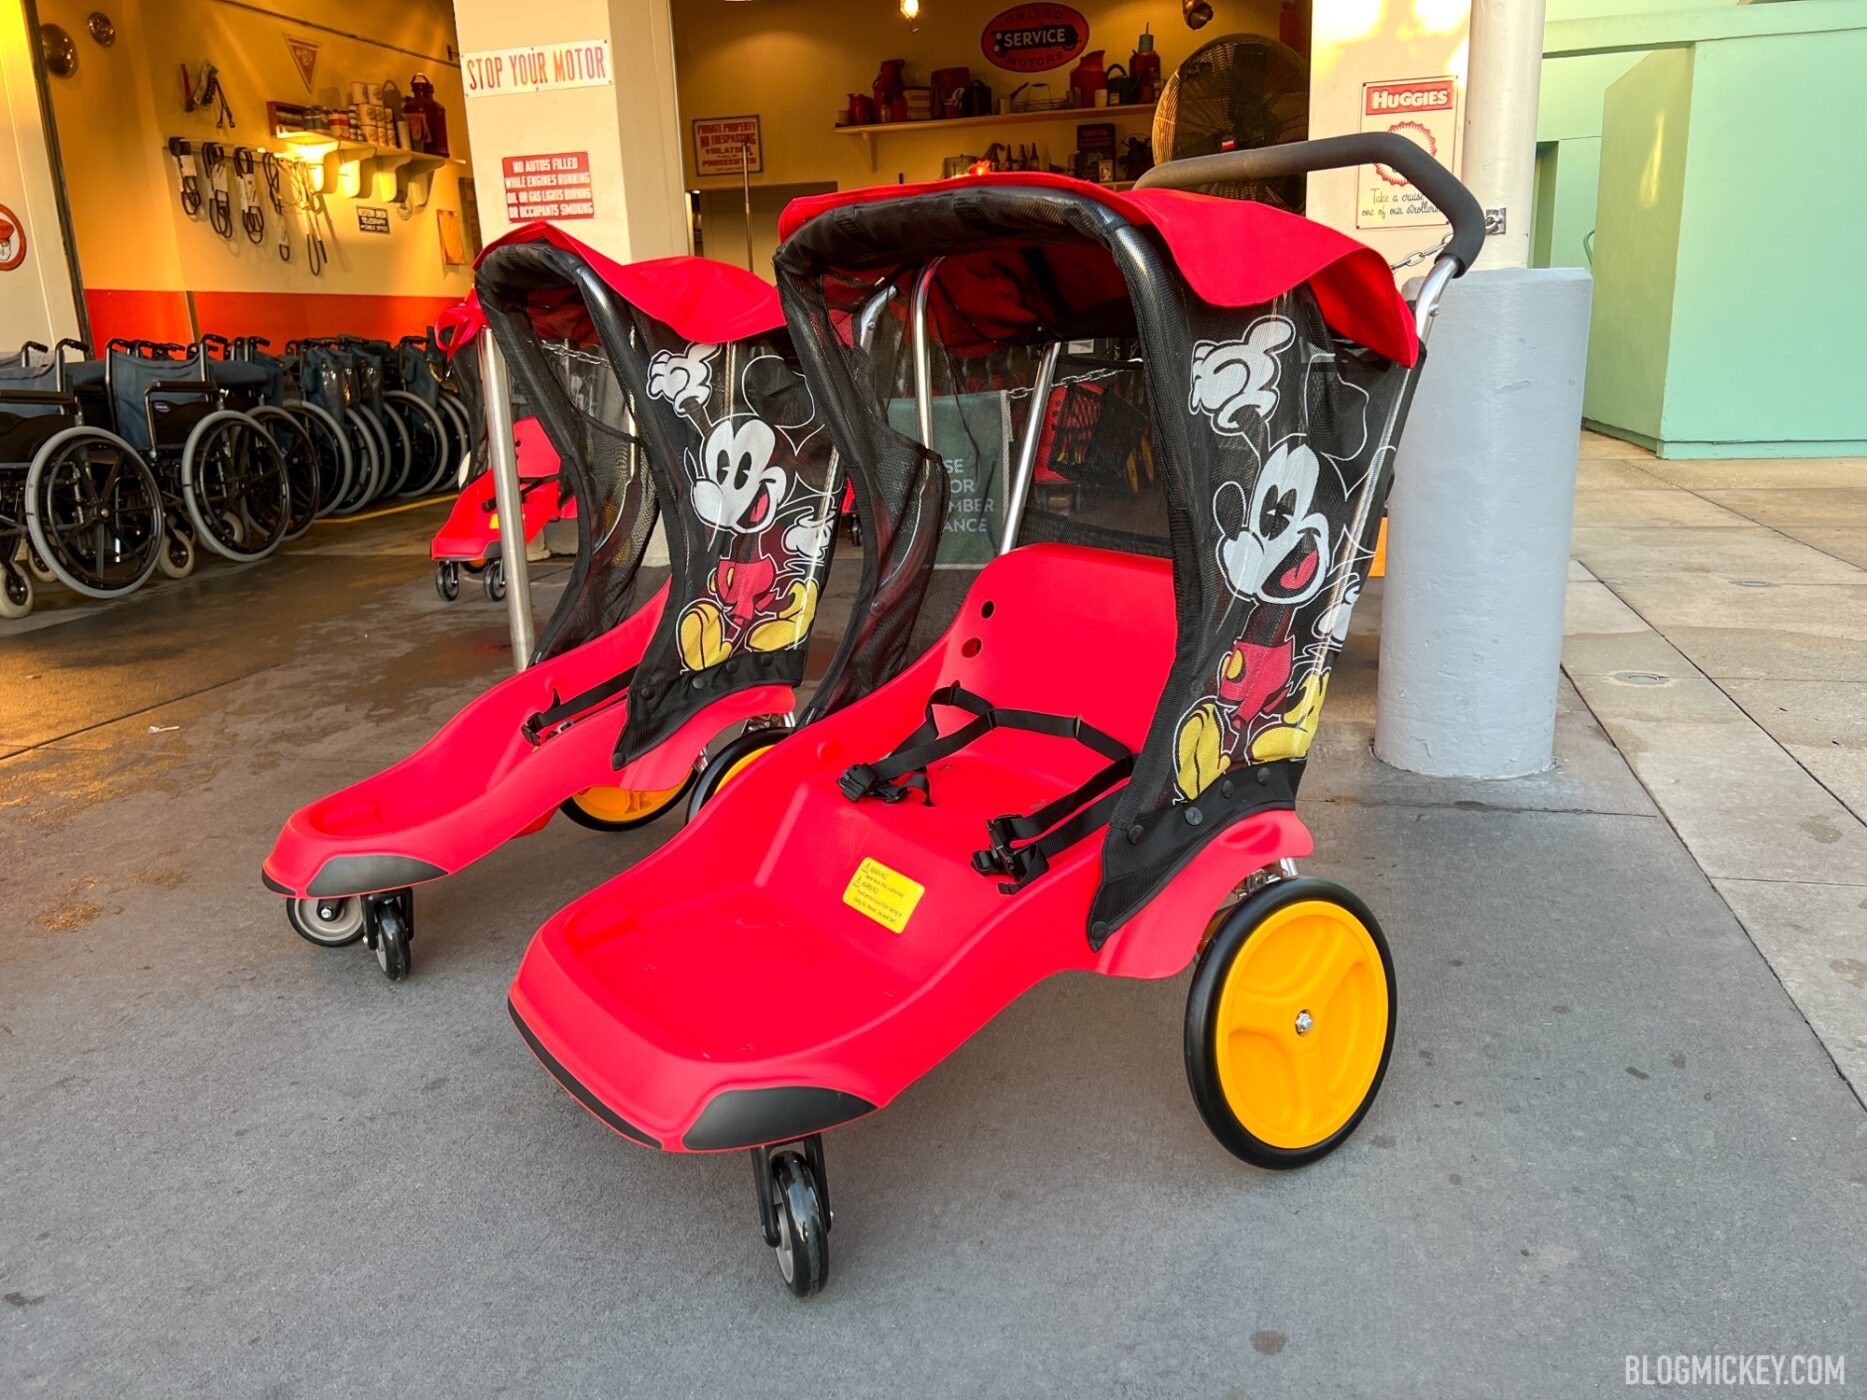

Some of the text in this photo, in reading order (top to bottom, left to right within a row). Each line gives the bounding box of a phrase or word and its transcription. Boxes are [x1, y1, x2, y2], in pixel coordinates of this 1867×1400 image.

[1004, 28, 1066, 47] SERVICE
[1007, 50, 1064, 67] MOTORS
[467, 47, 606, 90] STOP YOUR MOTOR
[1372, 90, 1449, 109] HUGGIES
[513, 157, 578, 173] NO AUTOS FILLED
[505, 172, 590, 188] WHILE ENGINES RUNNING
[529, 190, 542, 202] GAS
[542, 189, 564, 201] LIGHTS
[1371, 187, 1389, 204] Take
[508, 202, 593, 219] OR OCCUPANTS SMOKING
[1361, 208, 1374, 216] one
[1378, 204, 1387, 220] of
[1389, 207, 1404, 215] our
[943, 458, 964, 474] SE
[950, 479, 976, 494] OR
[948, 498, 994, 513] MBER
[943, 518, 988, 533] ANCE
